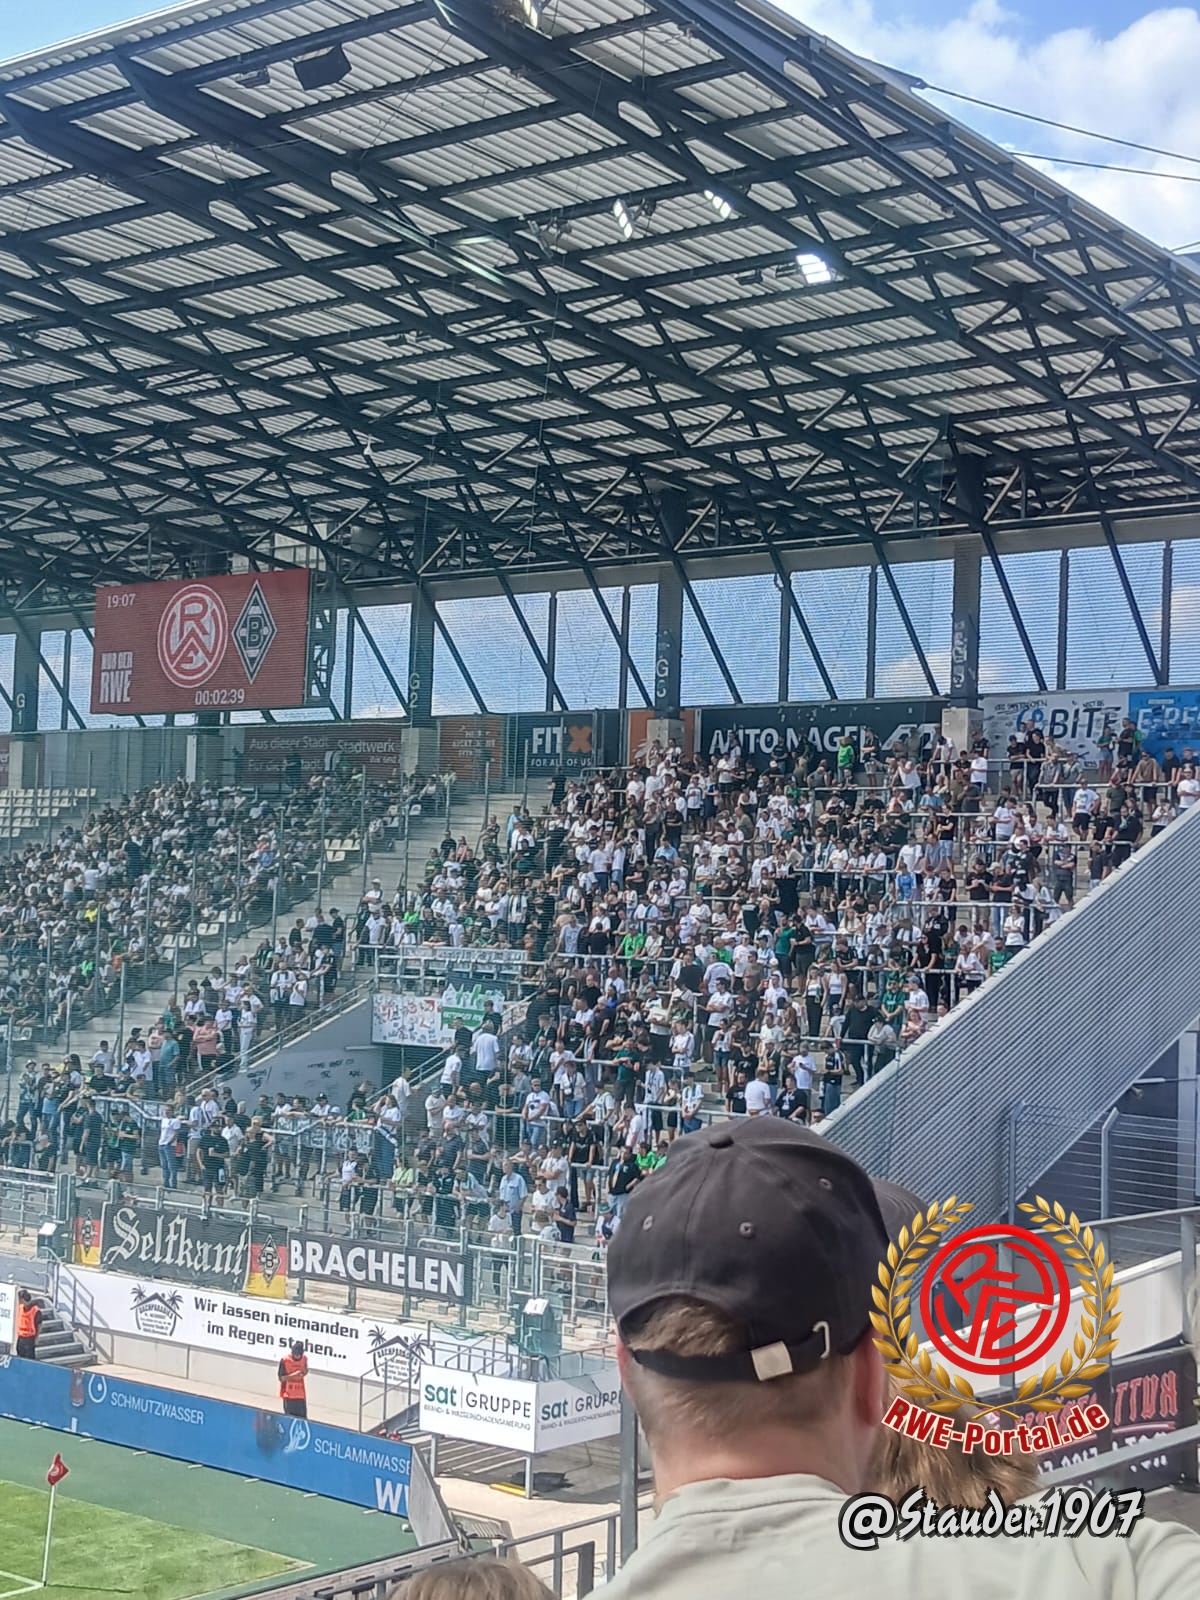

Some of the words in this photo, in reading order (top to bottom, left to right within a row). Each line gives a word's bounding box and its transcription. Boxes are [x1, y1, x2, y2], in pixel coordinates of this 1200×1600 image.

[107, 594, 136, 608] 19:07
[100, 670, 132, 704] RWE
[250, 739, 268, 750] Aus
[531, 758, 547, 767] FOR
[567, 758, 578, 767] OF
[581, 758, 592, 767] US
[290, 1239, 464, 1296] BRACHELEN
[194, 1297, 217, 1313] Wir
[222, 1302, 270, 1323] lassen
[274, 1312, 359, 1339] niemanden
[207, 1321, 224, 1336] im
[228, 1325, 274, 1345] Regen
[111, 1391, 204, 1425] SCHMUTZWASSER
[424, 1384, 457, 1407] sat
[465, 1391, 531, 1418] GRUPPE
[541, 1398, 569, 1421] sat
[375, 1477, 410, 1513] W
